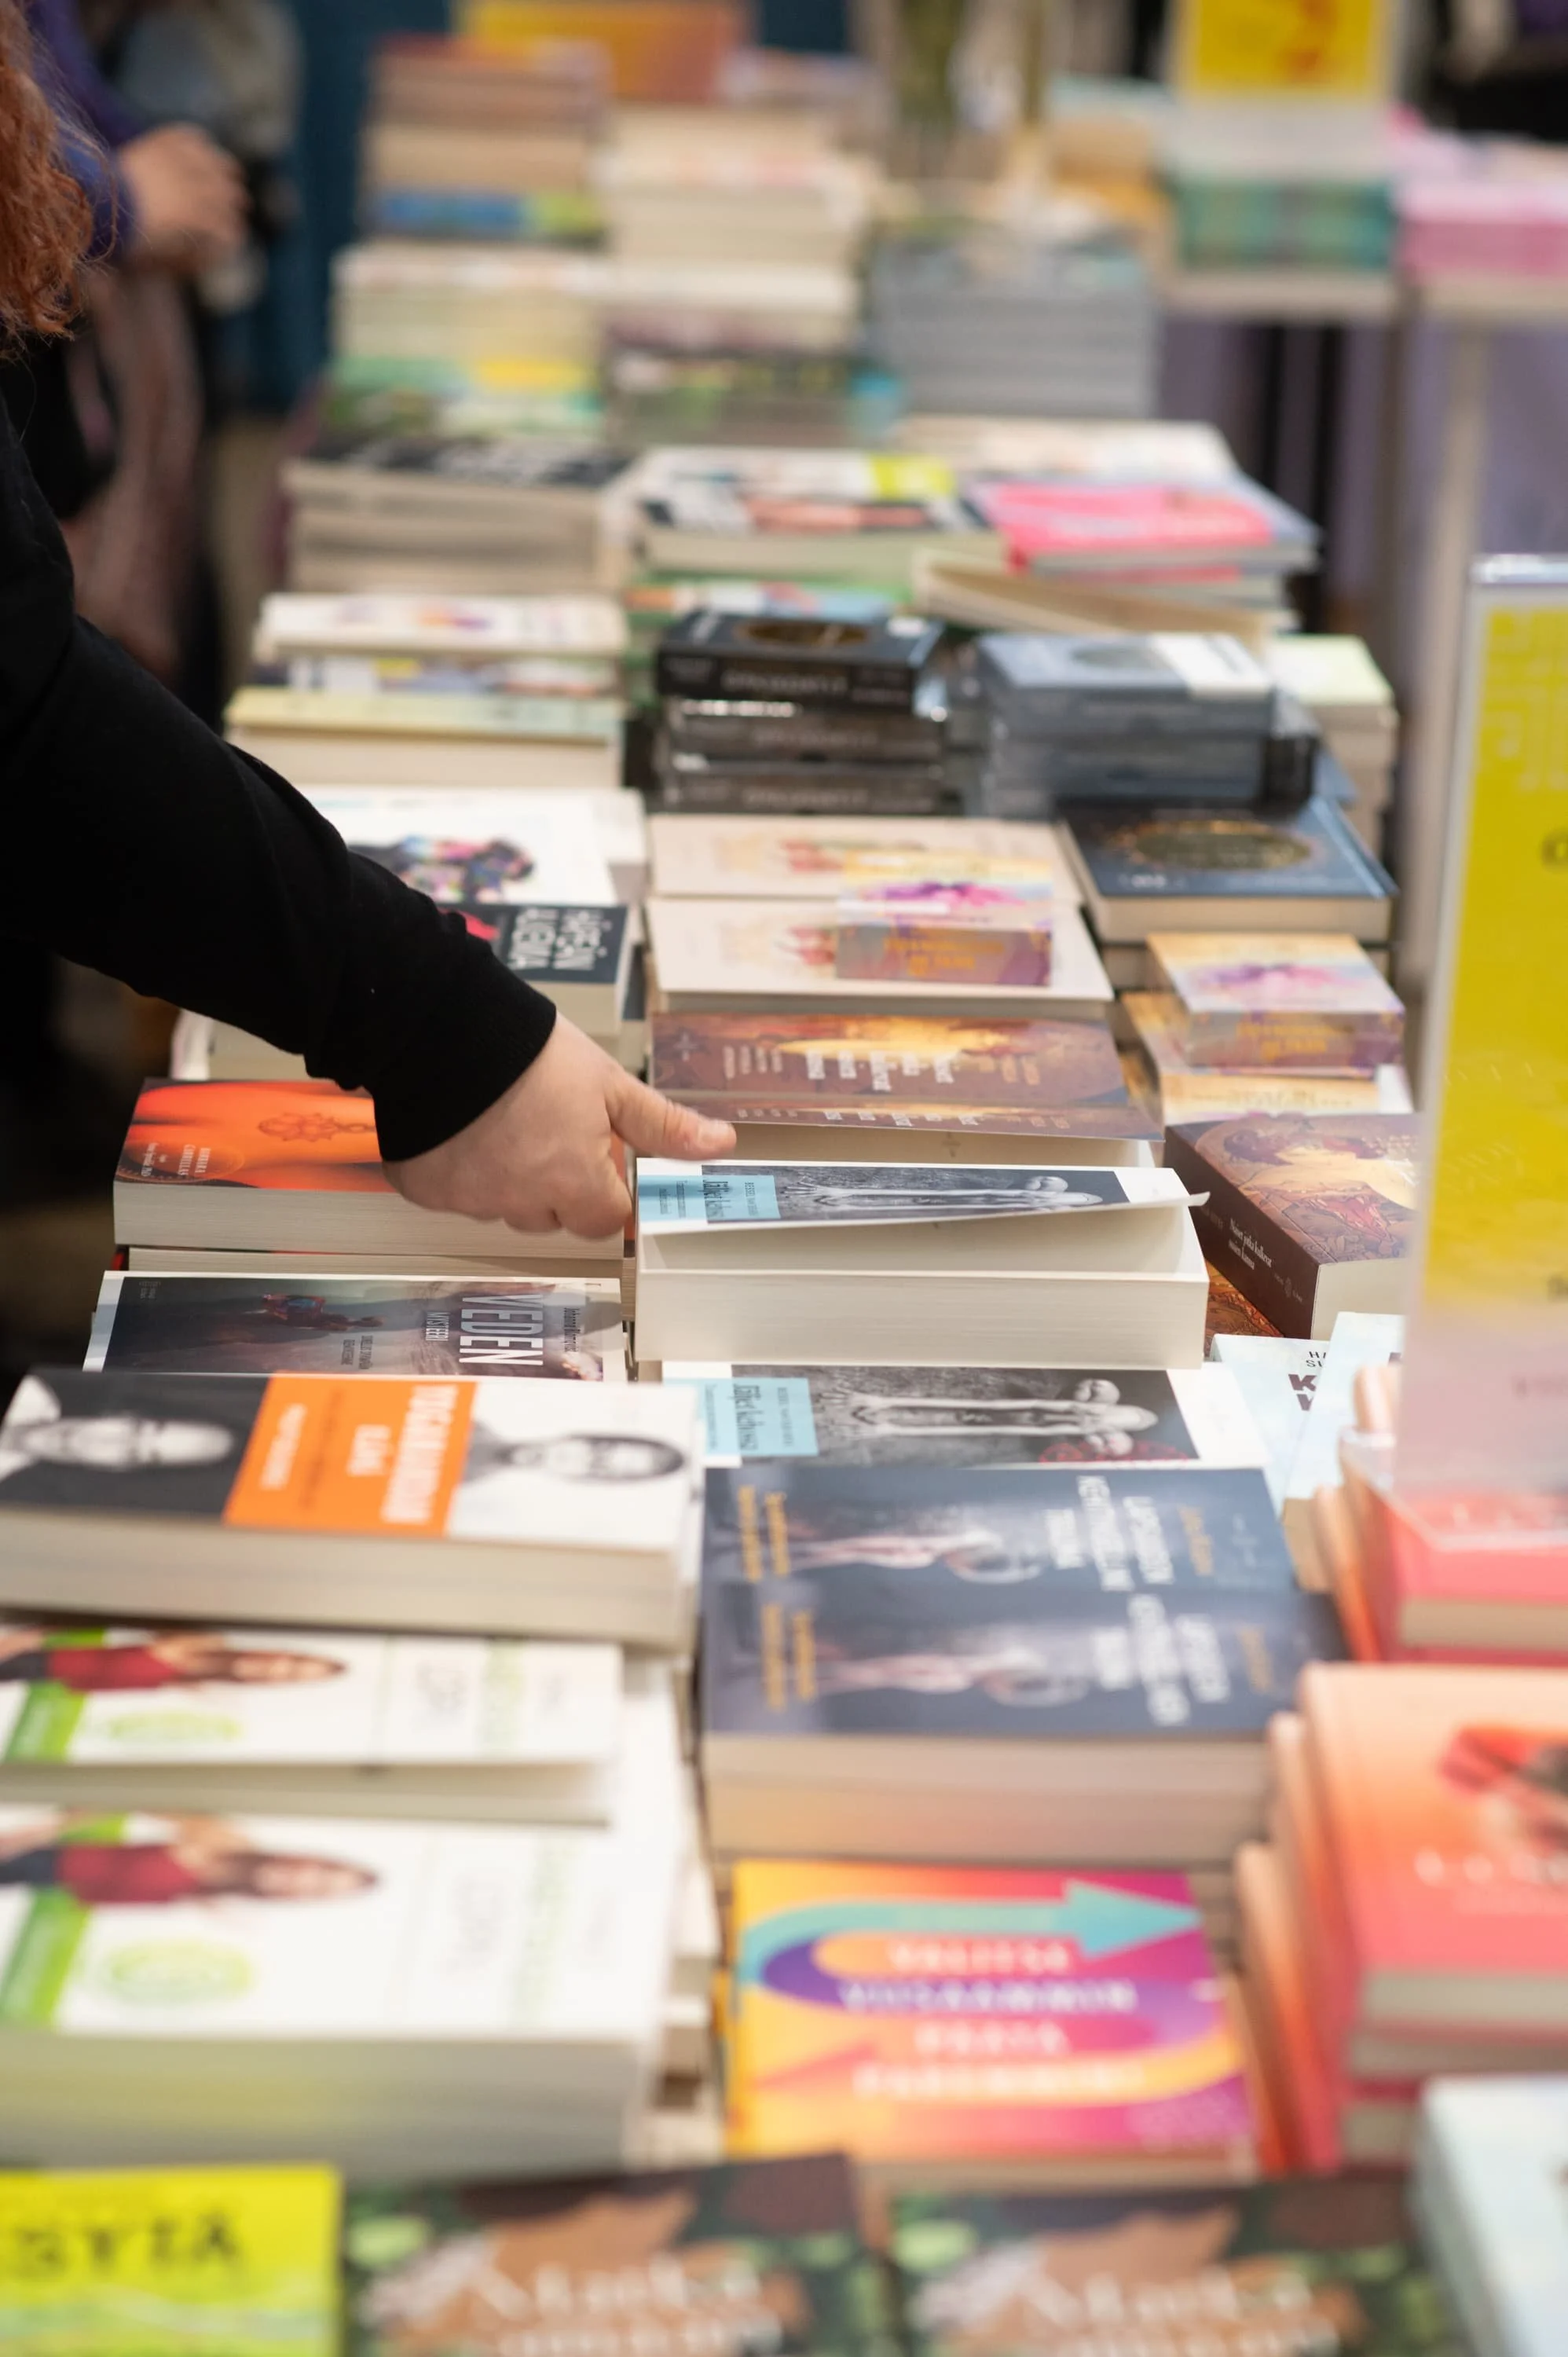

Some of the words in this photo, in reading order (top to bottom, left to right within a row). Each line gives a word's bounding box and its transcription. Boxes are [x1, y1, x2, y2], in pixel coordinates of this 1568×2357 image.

[424, 1311, 451, 1341] MYSTEERI
[458, 1293, 544, 1365] VEDEN
[563, 1307, 582, 1328] Johanna
[561, 1328, 581, 1353] Blomqvist
